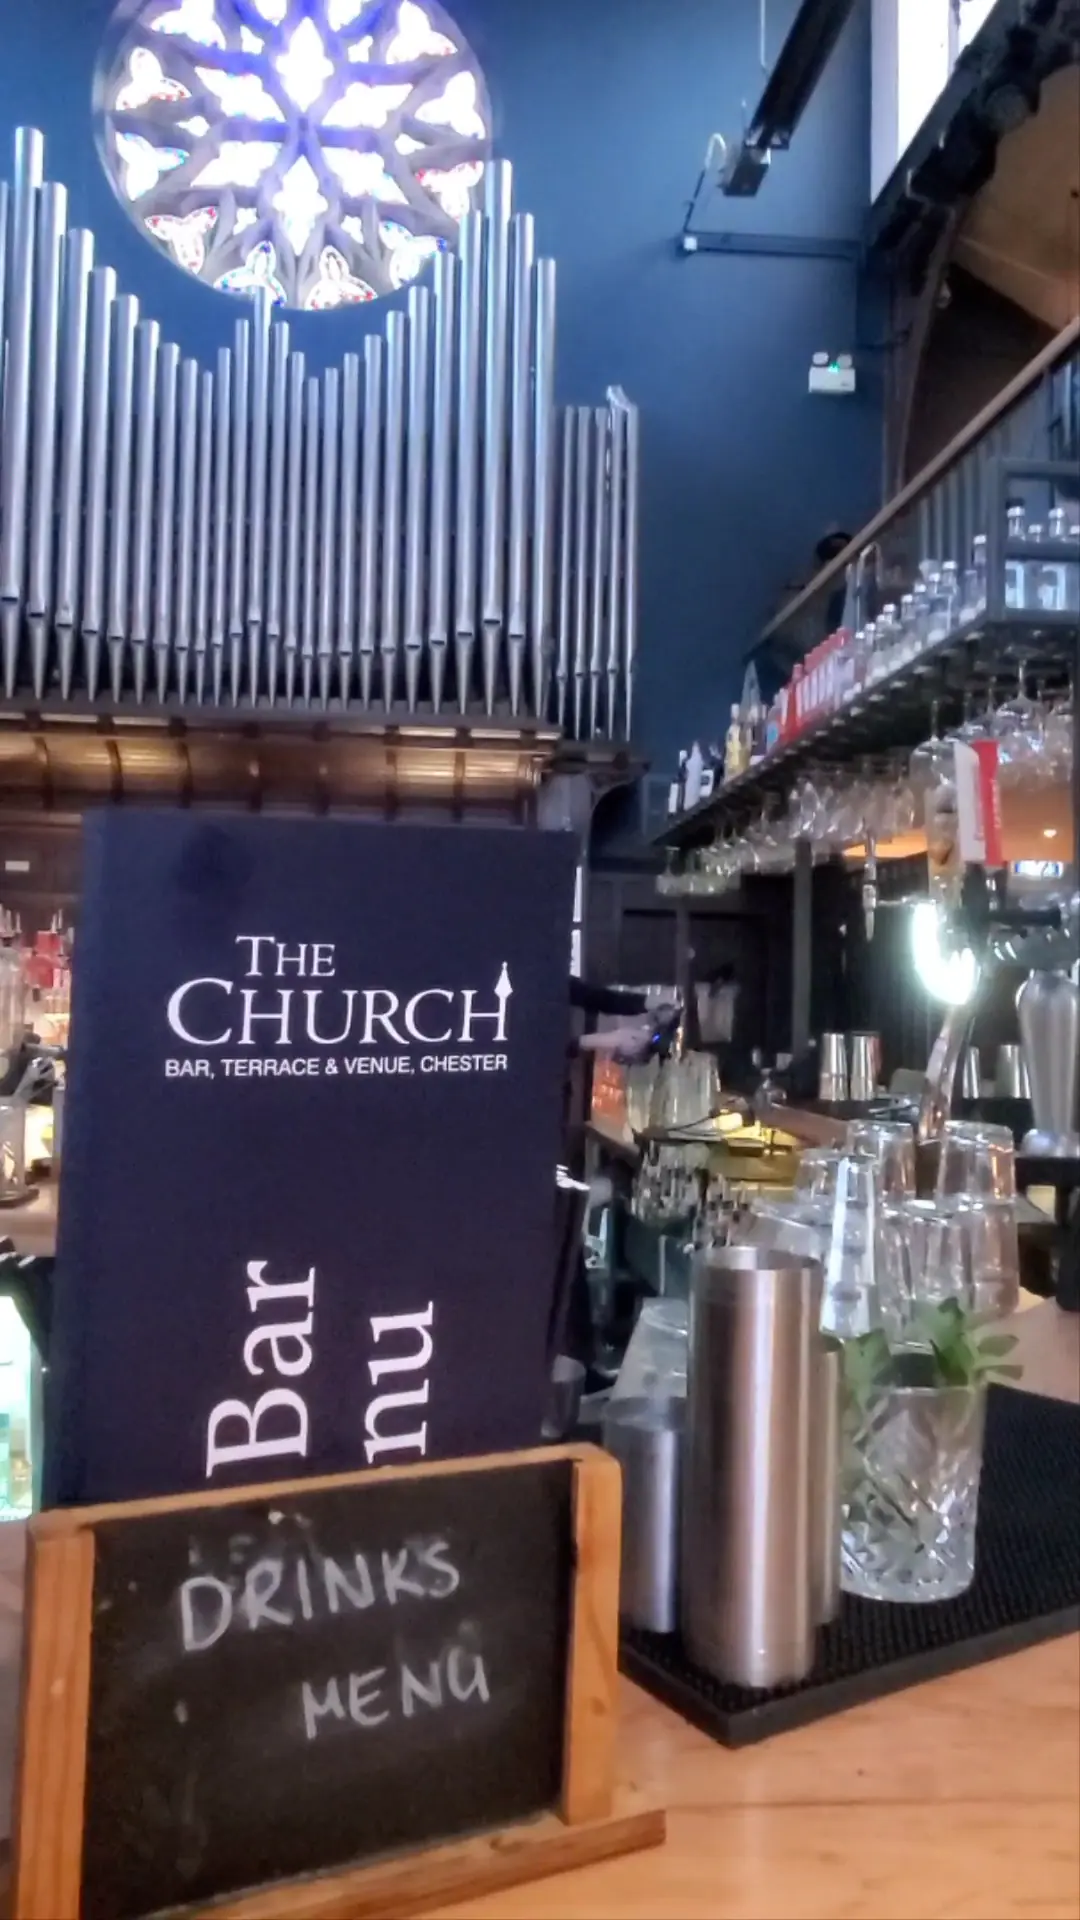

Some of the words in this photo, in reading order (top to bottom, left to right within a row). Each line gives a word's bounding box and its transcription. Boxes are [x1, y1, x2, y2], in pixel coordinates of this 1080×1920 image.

[166, 961, 513, 1045] CHURCH
[165, 1058, 215, 1080] BAR,
[221, 1058, 320, 1077] TERRACE
[325, 1058, 339, 1075] &
[344, 1056, 415, 1075] VENUE,
[420, 1054, 508, 1073] CHESTER
[206, 1260, 315, 1478] Bar
[364, 1300, 433, 1464] nu
[181, 1541, 460, 1652] DRINKS
[302, 1645, 490, 1739] MENU
